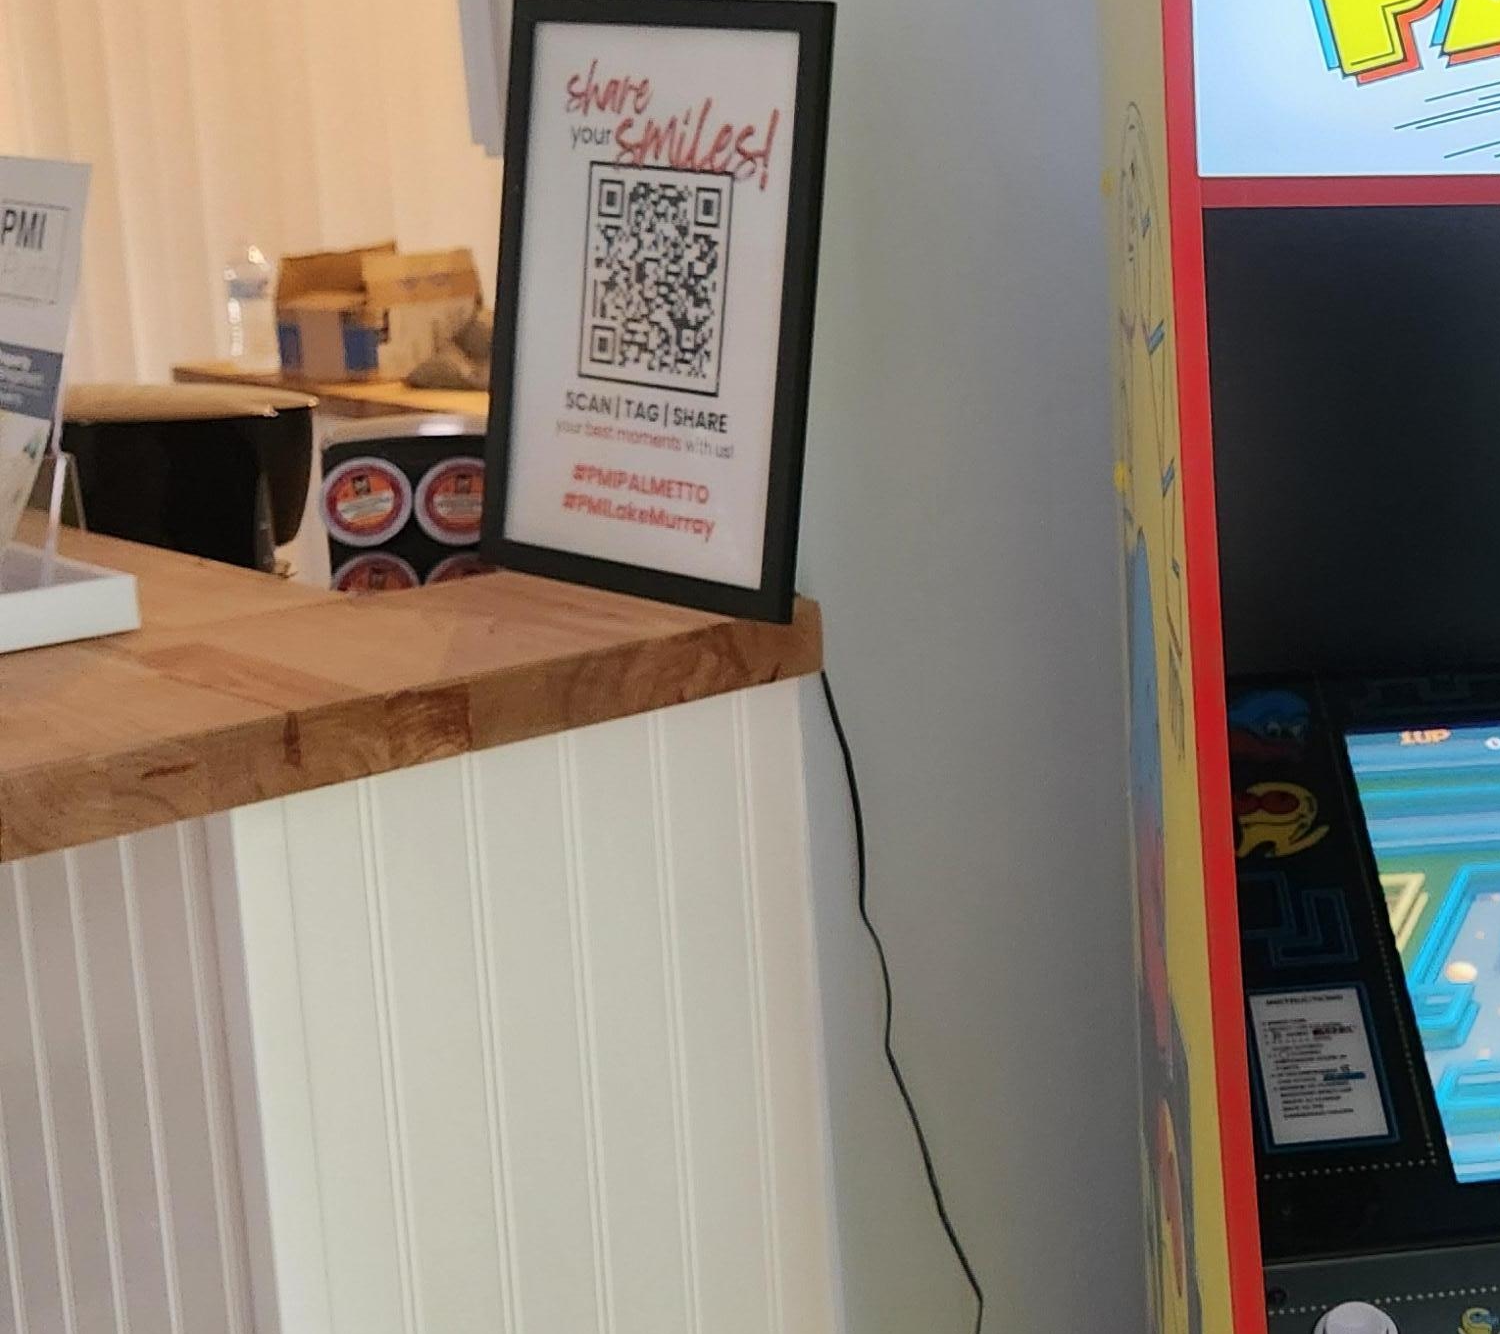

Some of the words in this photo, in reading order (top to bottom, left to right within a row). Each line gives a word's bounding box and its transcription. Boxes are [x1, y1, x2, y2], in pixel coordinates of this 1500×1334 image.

[566, 58, 651, 115] share
[570, 124, 613, 149] your
[614, 96, 780, 192] smiles!
[0, 209, 47, 251] PMI
[565, 390, 612, 415] SCAN
[625, 399, 659, 423] TAG
[673, 407, 729, 434] SHARE
[572, 464, 710, 505] #PMIPALMETTO
[1400, 728, 1450, 745] 1UP
